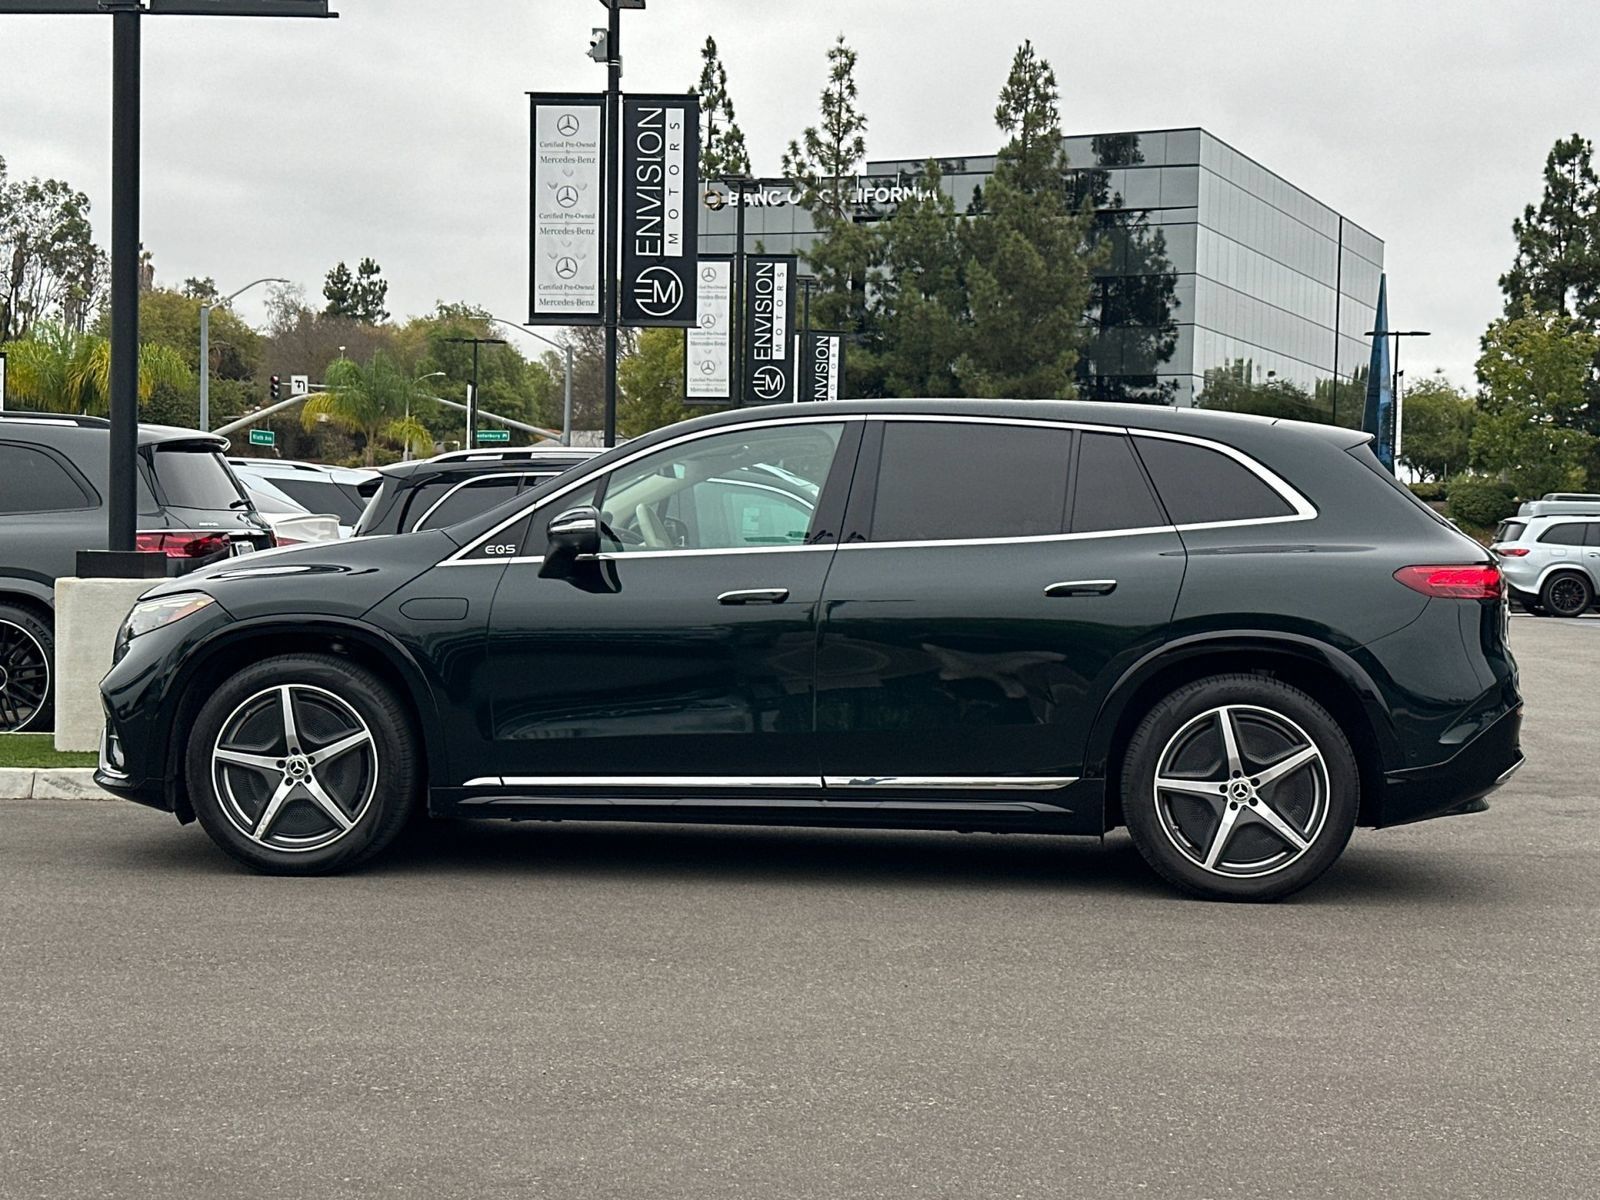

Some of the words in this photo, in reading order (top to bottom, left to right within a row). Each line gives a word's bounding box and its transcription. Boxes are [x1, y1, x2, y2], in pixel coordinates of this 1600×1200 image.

[540, 155, 596, 164] Mercedes-Benz
[635, 107, 663, 256] ENVISION
[668, 121, 681, 244] MOTORS
[539, 226, 595, 235] Mercedes-Benz
[539, 298, 595, 306] Mercedes-Benz
[753, 262, 773, 360] ENVISION
[775, 271, 785, 352] MOTORS
[485, 544, 516, 555] EQS
